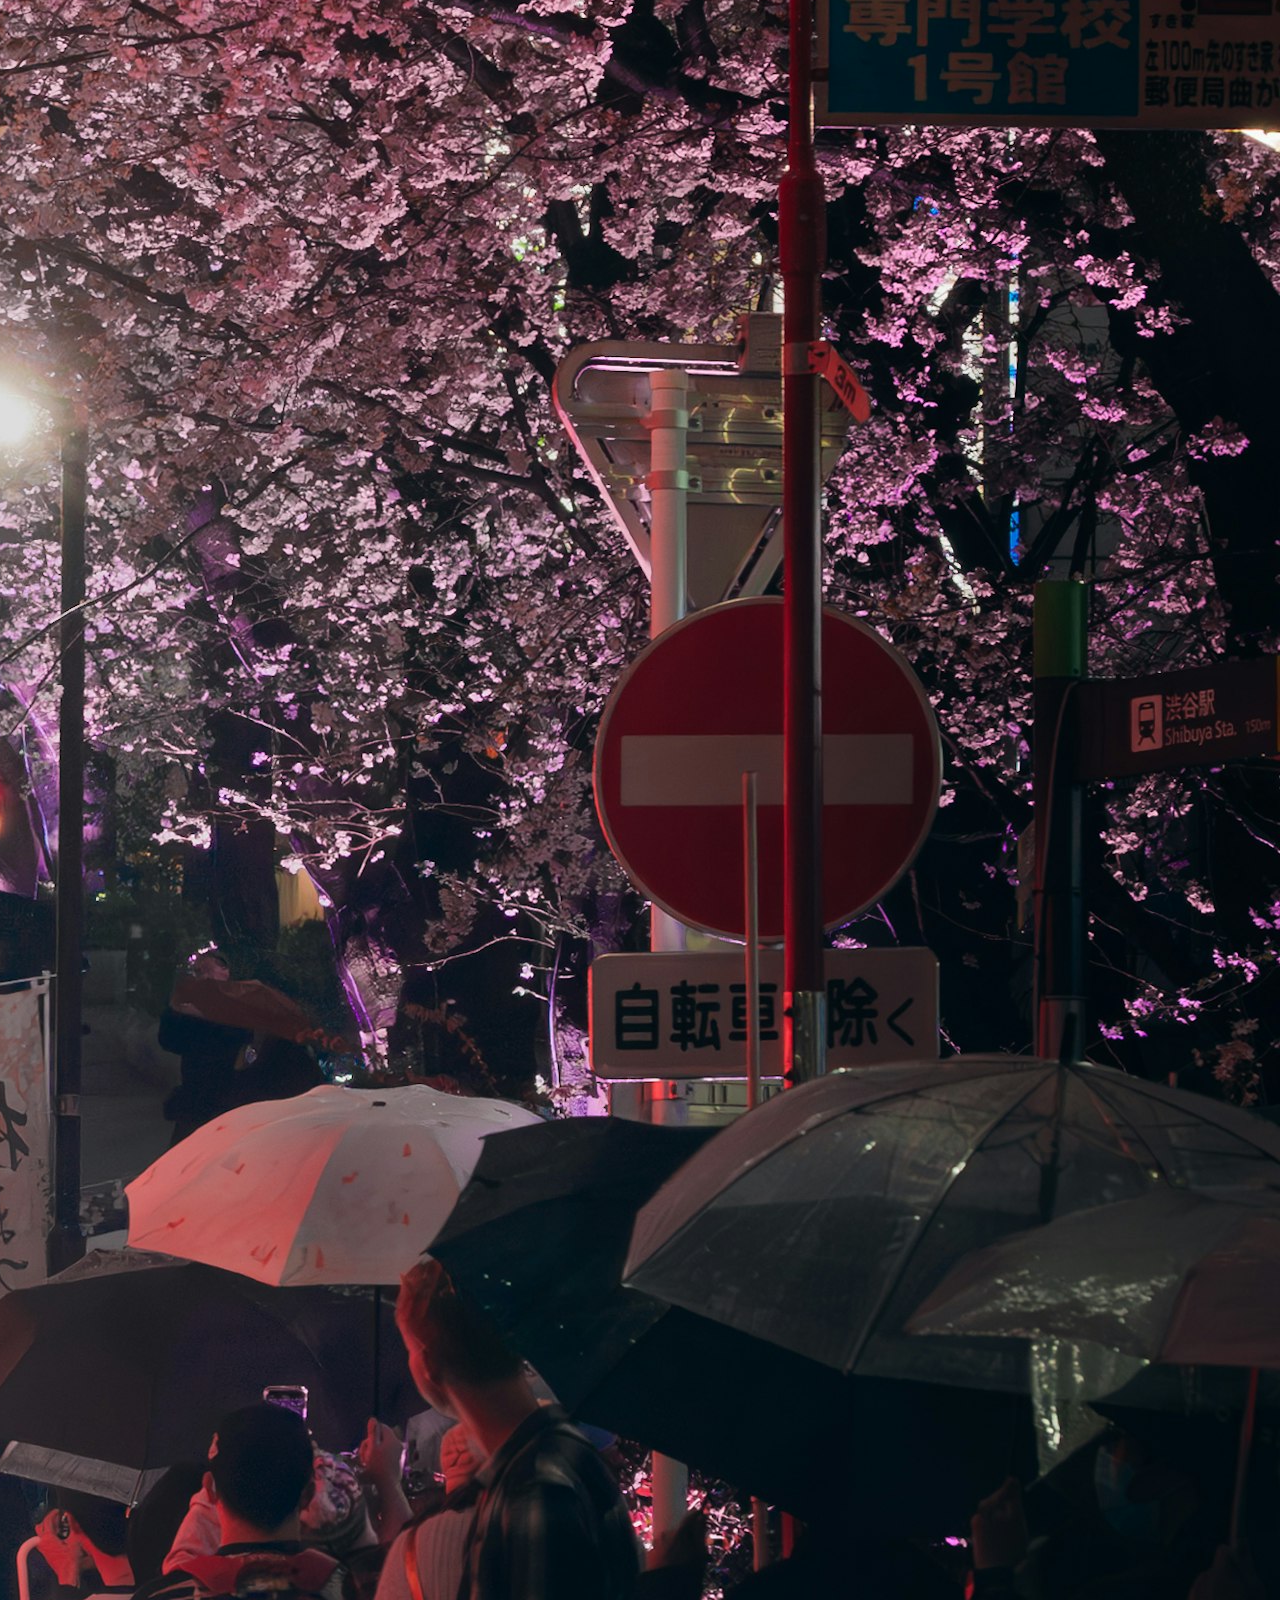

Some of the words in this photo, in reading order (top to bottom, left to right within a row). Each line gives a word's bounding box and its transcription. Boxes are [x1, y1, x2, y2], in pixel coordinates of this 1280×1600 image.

[1145, 39, 1280, 72] 左100m先のすき家
[906, 51, 1070, 106] 1号館
[1165, 689, 1216, 721] 渋谷駅
[1165, 724, 1213, 746] Shibuya
[1214, 719, 1237, 739] Sta.
[1244, 717, 1272, 734] 150m
[615, 978, 915, 1051] 自転車除く
